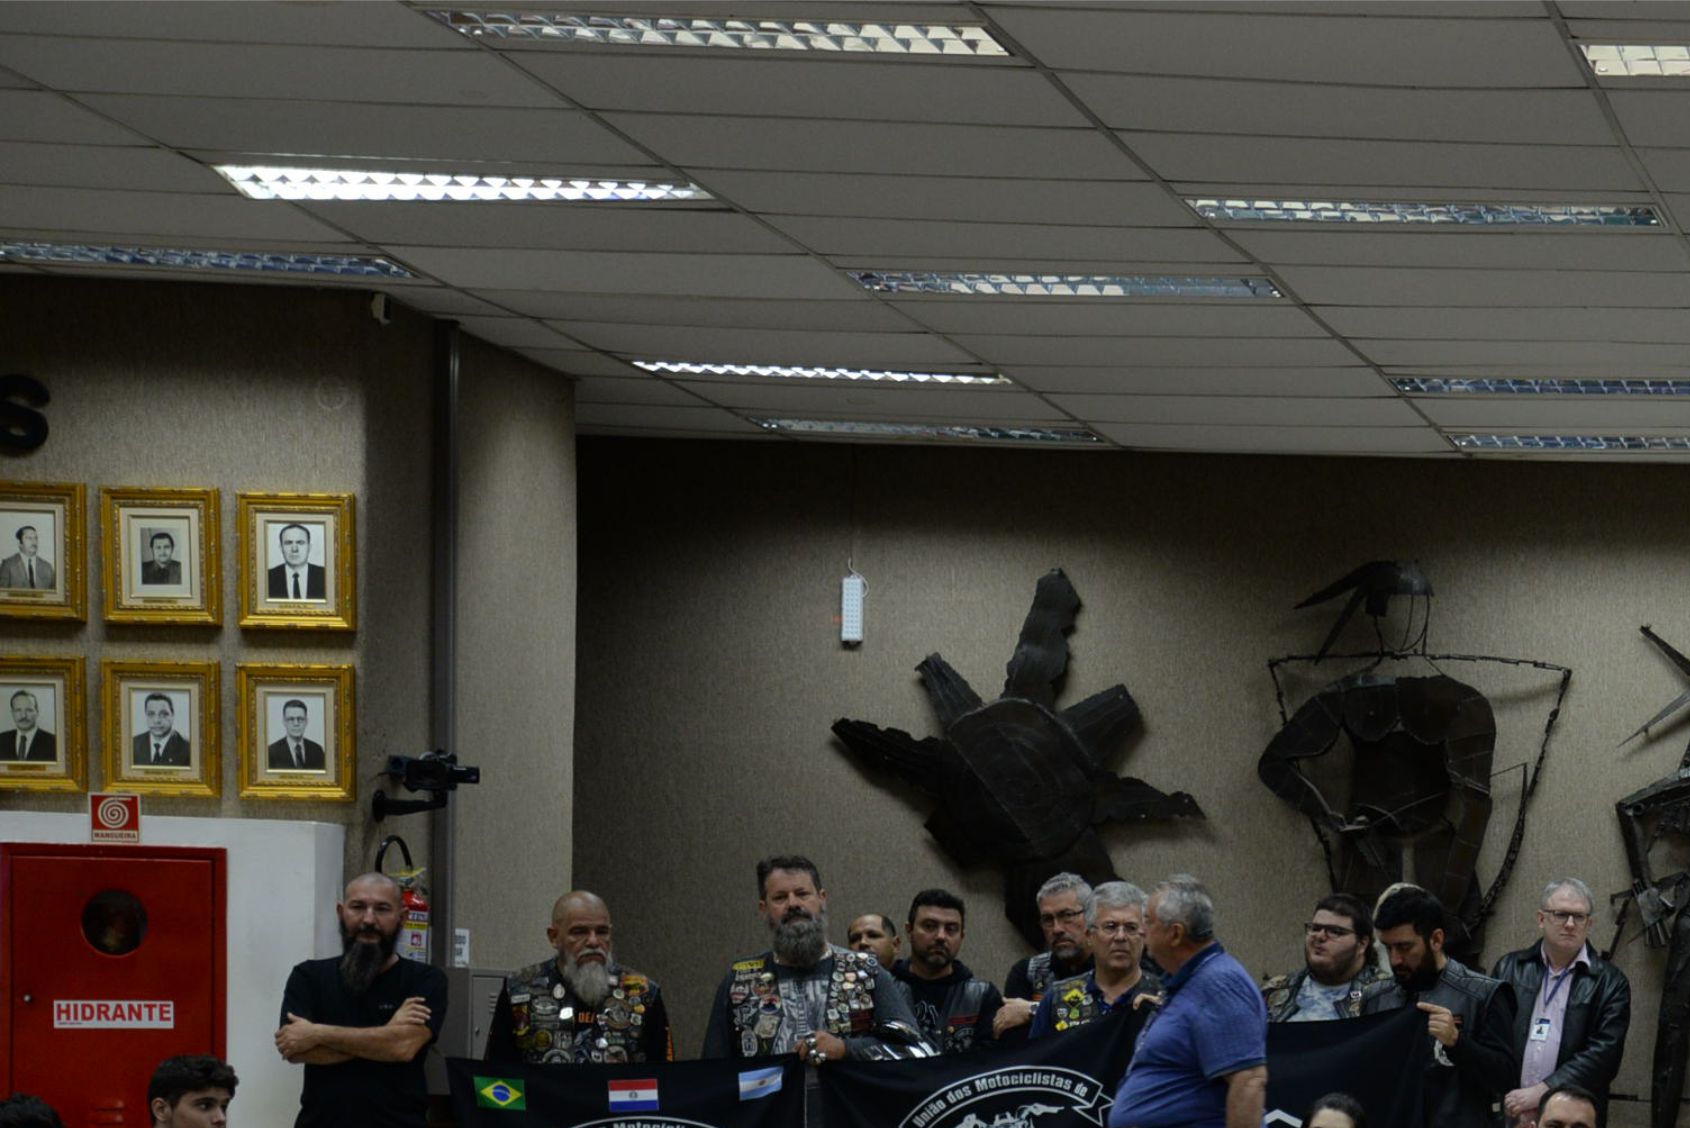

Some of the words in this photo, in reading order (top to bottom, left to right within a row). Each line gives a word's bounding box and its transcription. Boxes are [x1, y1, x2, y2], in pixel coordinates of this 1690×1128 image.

[57, 1003, 171, 1021] HIDRANTE
[912, 1101, 947, 1128] União
[949, 1085, 972, 1104] dos
[975, 1072, 1072, 1093] Motociclistas
[1074, 1082, 1088, 1097] de
